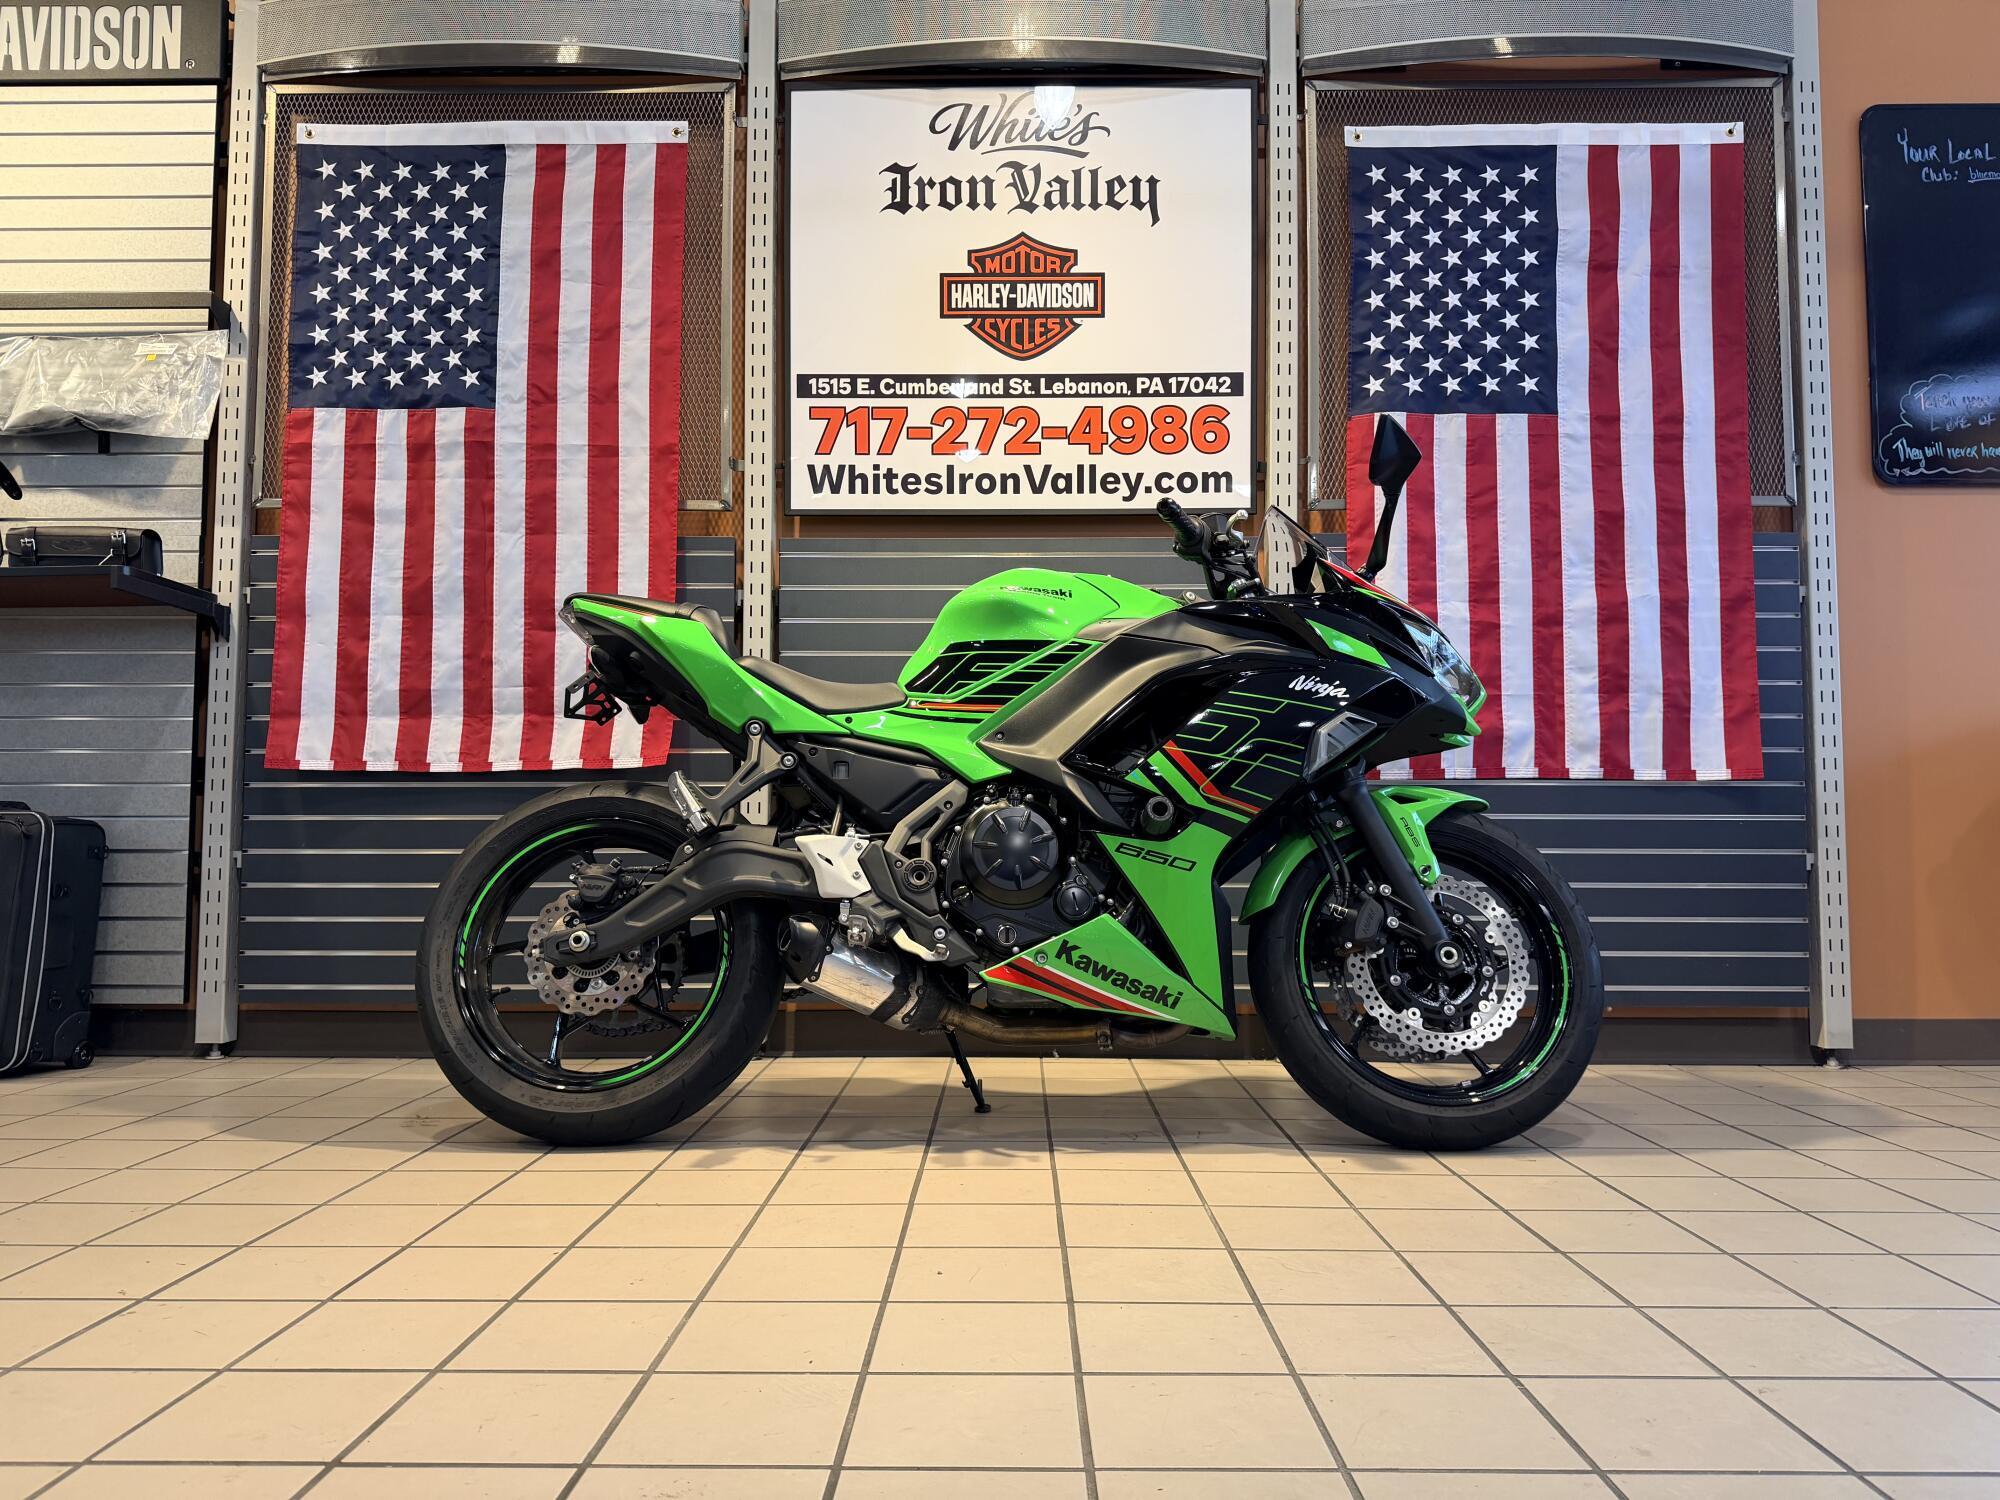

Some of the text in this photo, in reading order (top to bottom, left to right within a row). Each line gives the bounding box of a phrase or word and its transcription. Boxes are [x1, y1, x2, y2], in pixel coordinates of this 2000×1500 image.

[878, 160, 1162, 228] Iron Valley
[985, 245, 1061, 274] MOTOR
[951, 283, 1095, 309] HARLEY-DAVIDSON
[984, 317, 1060, 351] CYCLES
[808, 378, 852, 395] 1515
[856, 378, 875, 395] E.
[1008, 377, 1036, 394] St.
[1040, 377, 1132, 397] Lebanon,
[1136, 377, 1164, 394] PA
[1168, 376, 1231, 394] 17042
[808, 404, 1231, 456] 717-272-4986
[1924, 441, 1944, 458] will
[807, 463, 1234, 501] WhitesIronValley.com
[1288, 674, 1350, 699] Ninja
[1400, 816, 1420, 848] ABS
[1115, 842, 1197, 872] 650
[1054, 938, 1184, 1010] Kawasaki
